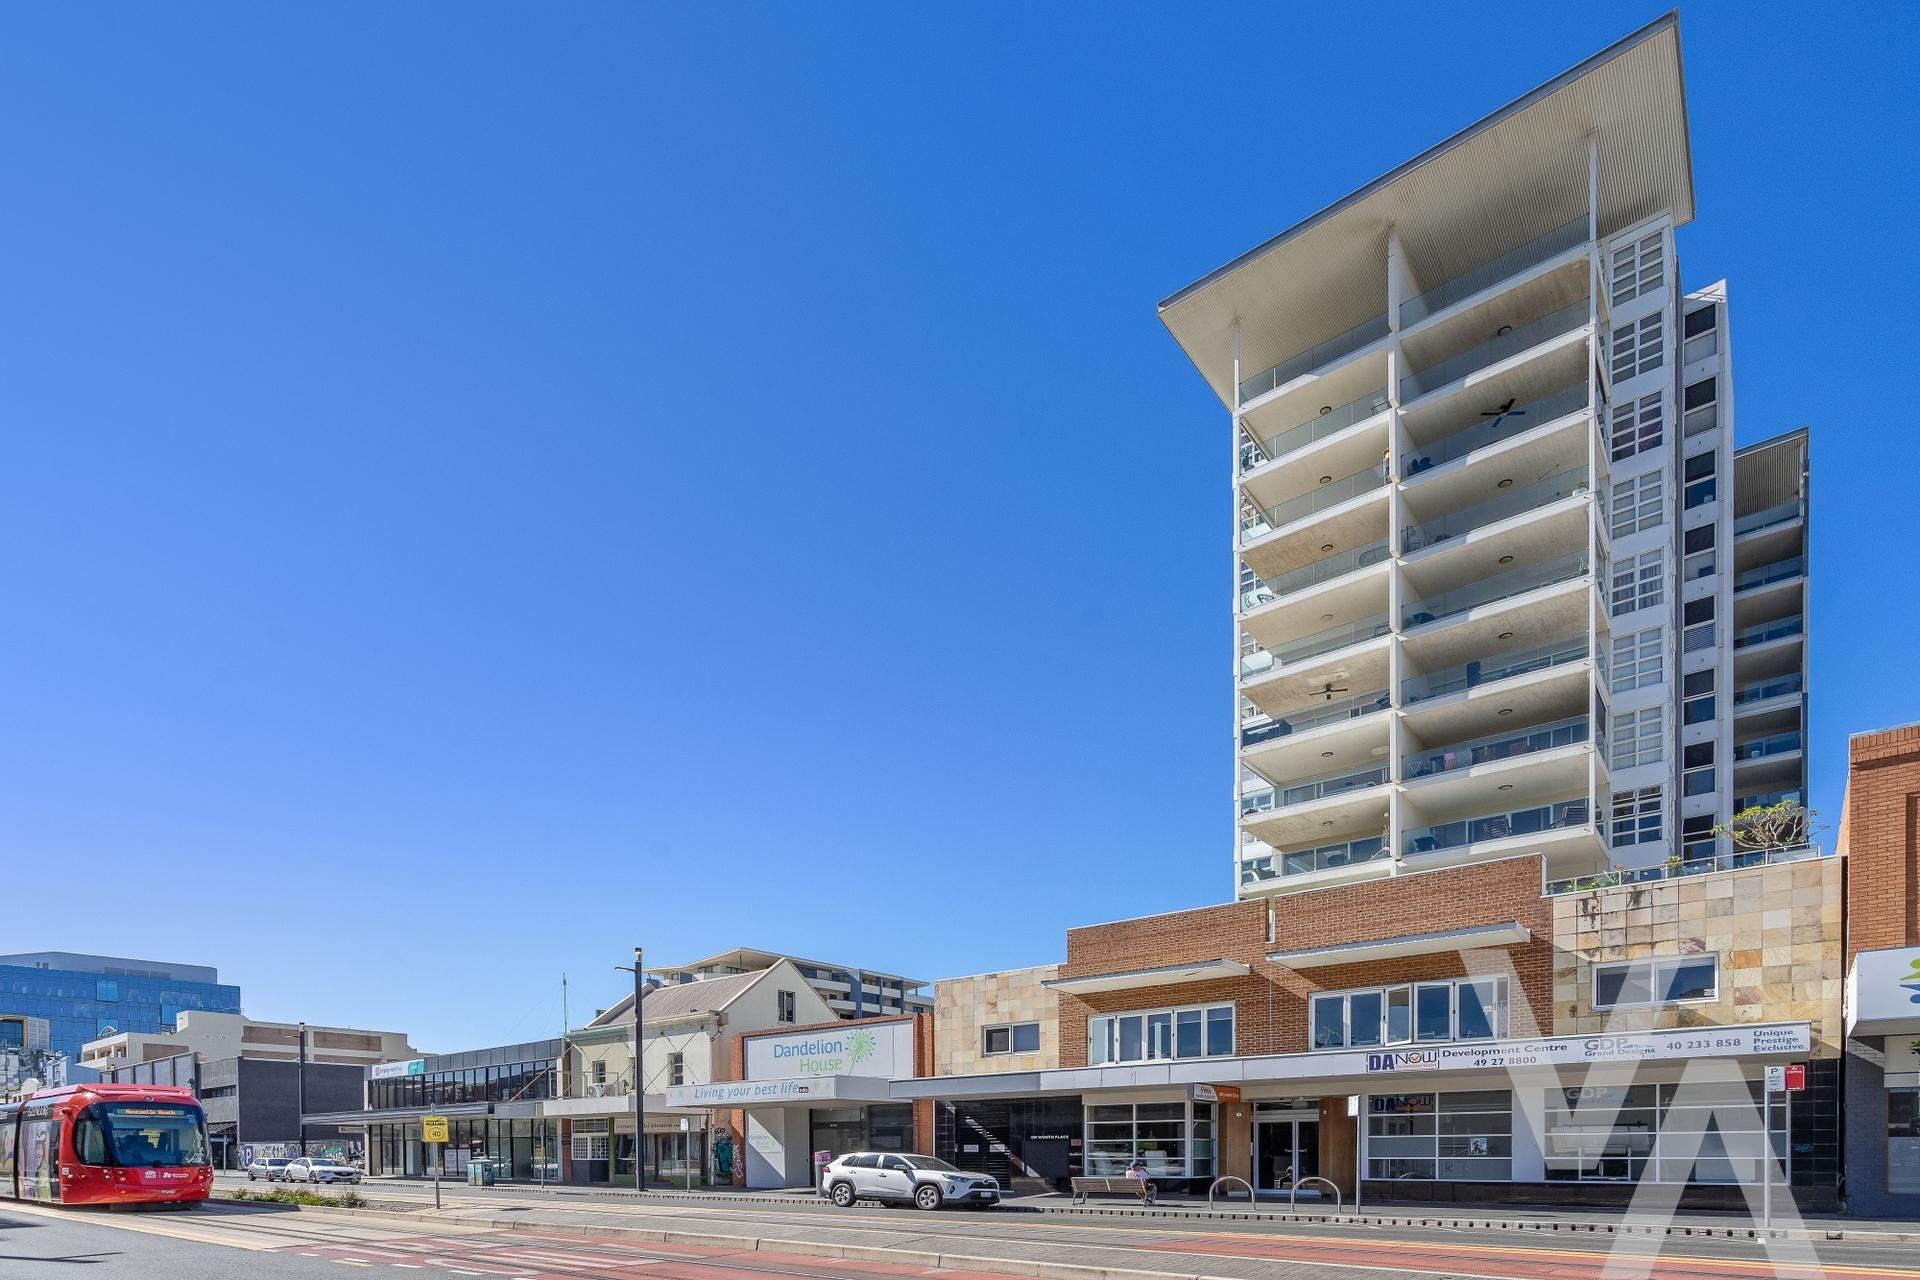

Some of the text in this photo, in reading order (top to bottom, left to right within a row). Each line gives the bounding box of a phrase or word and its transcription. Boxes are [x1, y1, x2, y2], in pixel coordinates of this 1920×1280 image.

[1753, 1029, 1794, 1037] Unique
[1584, 1038, 1629, 1050] GDP
[1666, 1038, 1741, 1050] 40 233 858
[1753, 1036, 1799, 1045] Prestige
[774, 1039, 842, 1058] Dandelion
[1442, 1044, 1568, 1058] Development Centre
[1617, 1047, 1656, 1058] Designs
[1753, 1044, 1805, 1052] Exclusive
[800, 1058, 843, 1073] House
[1474, 1056, 1537, 1067] 49 27 8800
[1771, 1067, 1779, 1075] P
[694, 1082, 799, 1100] Living your best life
